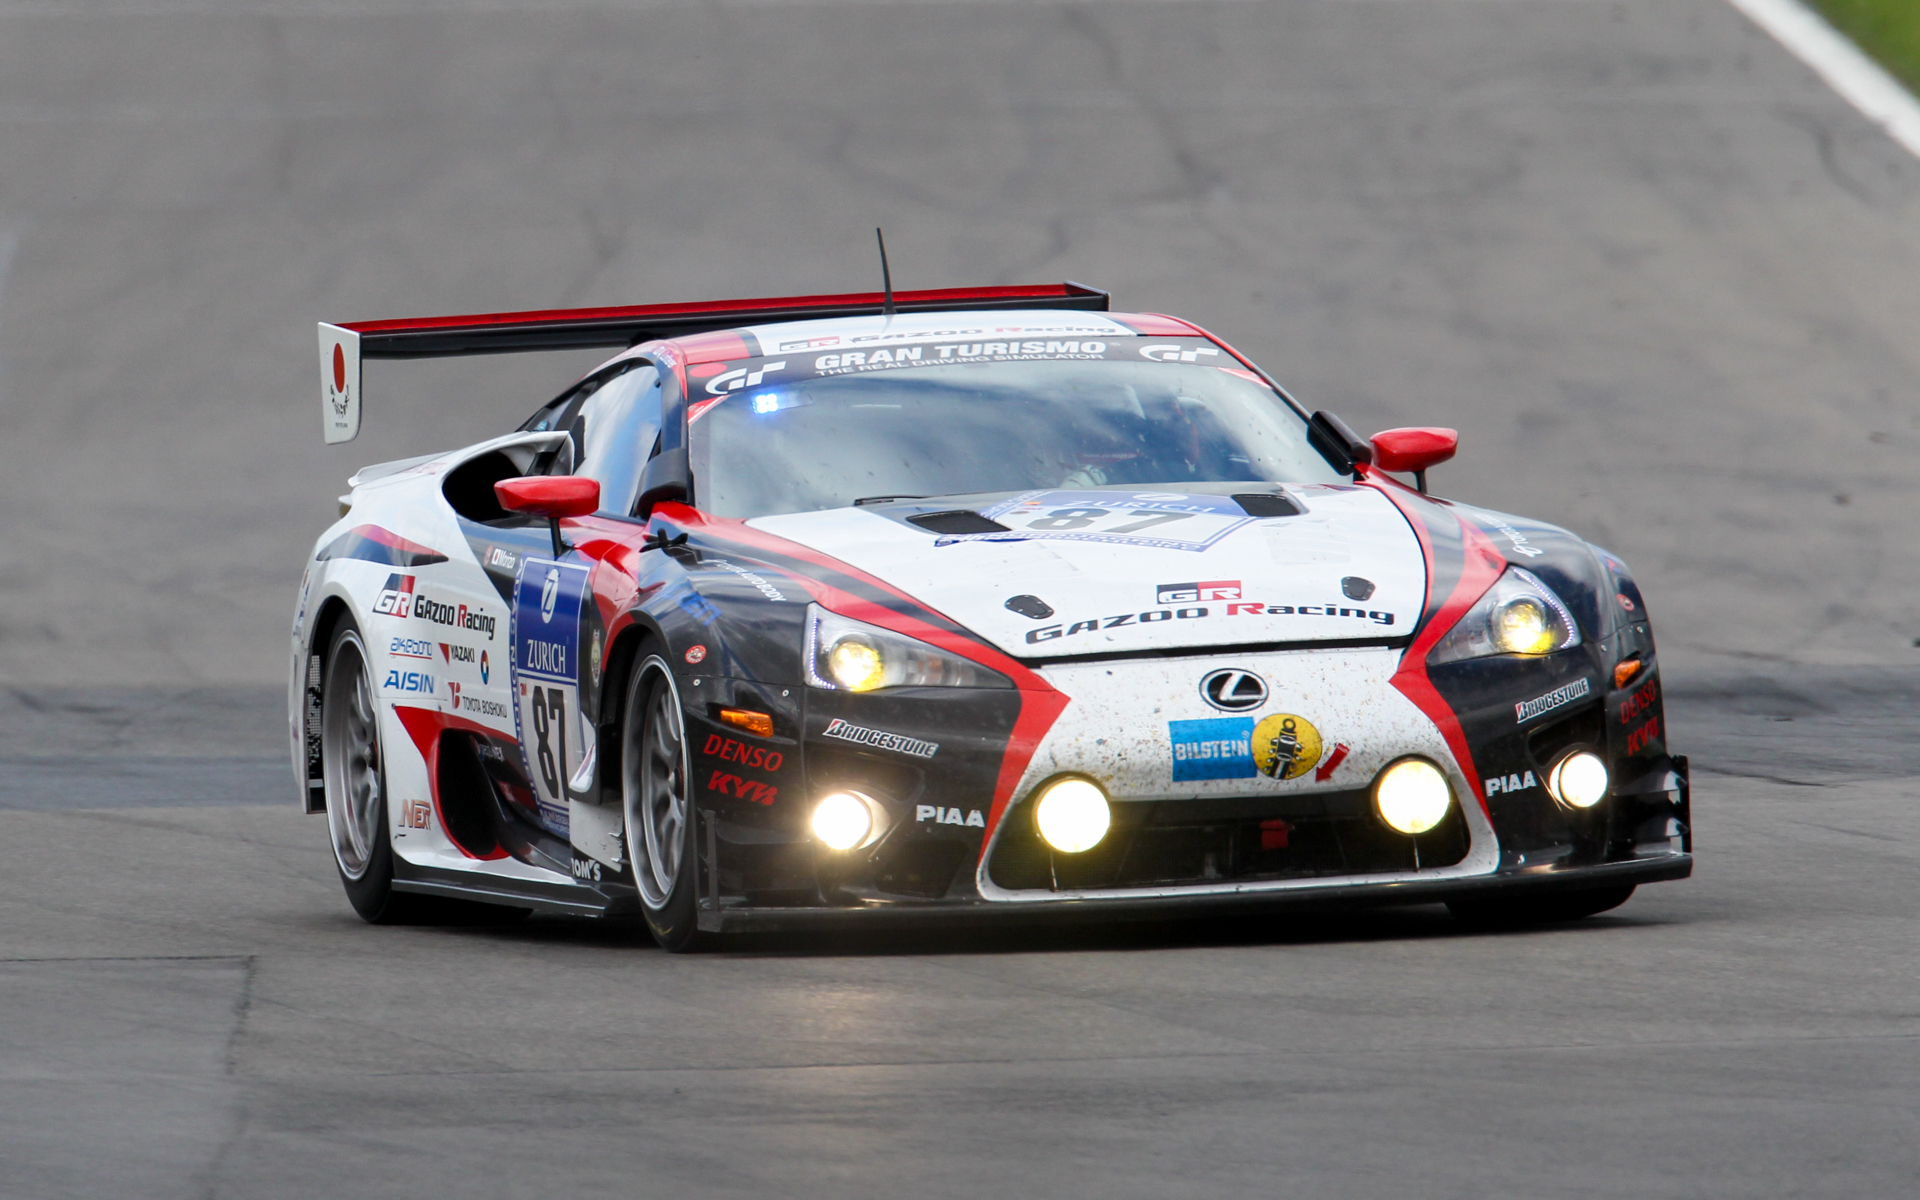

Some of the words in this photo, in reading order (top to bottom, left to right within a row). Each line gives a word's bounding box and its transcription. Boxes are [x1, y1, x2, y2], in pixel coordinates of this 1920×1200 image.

[781, 338, 839, 350] GR
[851, 329, 983, 342] GAZOO
[996, 326, 1115, 334] Racing
[815, 347, 922, 369] GRAN
[935, 341, 1106, 358] TURISMO
[816, 367, 854, 377] THE
[859, 361, 909, 372] REAL
[912, 355, 989, 367] DRIVING
[994, 353, 1104, 361] SIMULATOR
[1063, 500, 1216, 513] ZURICH
[1026, 507, 1195, 533] 87
[756, 583, 787, 602] BODY
[1157, 583, 1242, 604] GR
[373, 588, 413, 618] GR
[414, 595, 455, 625] GAZOO
[457, 604, 496, 640] Racing
[1025, 607, 1209, 645] GAZOO
[1226, 602, 1395, 626] Racing
[450, 644, 475, 663] YAZAKI
[527, 639, 566, 673] ZURICH
[383, 670, 434, 694] AISIN
[462, 696, 481, 713] TOYOTA
[482, 700, 508, 718] BOSHOKU
[1515, 677, 1590, 723] BRIDGESTONE
[1620, 680, 1656, 724] DENSO
[532, 686, 569, 802] 87
[822, 718, 940, 759] BRIDGESTONE
[1627, 716, 1659, 756] KYB
[703, 734, 783, 771] DENSO
[1175, 740, 1249, 761] BILSTEIN
[708, 770, 778, 805] KYB
[1485, 770, 1538, 797] PIAA
[916, 804, 986, 828] PIAA
[570, 858, 601, 882] TOM'S
